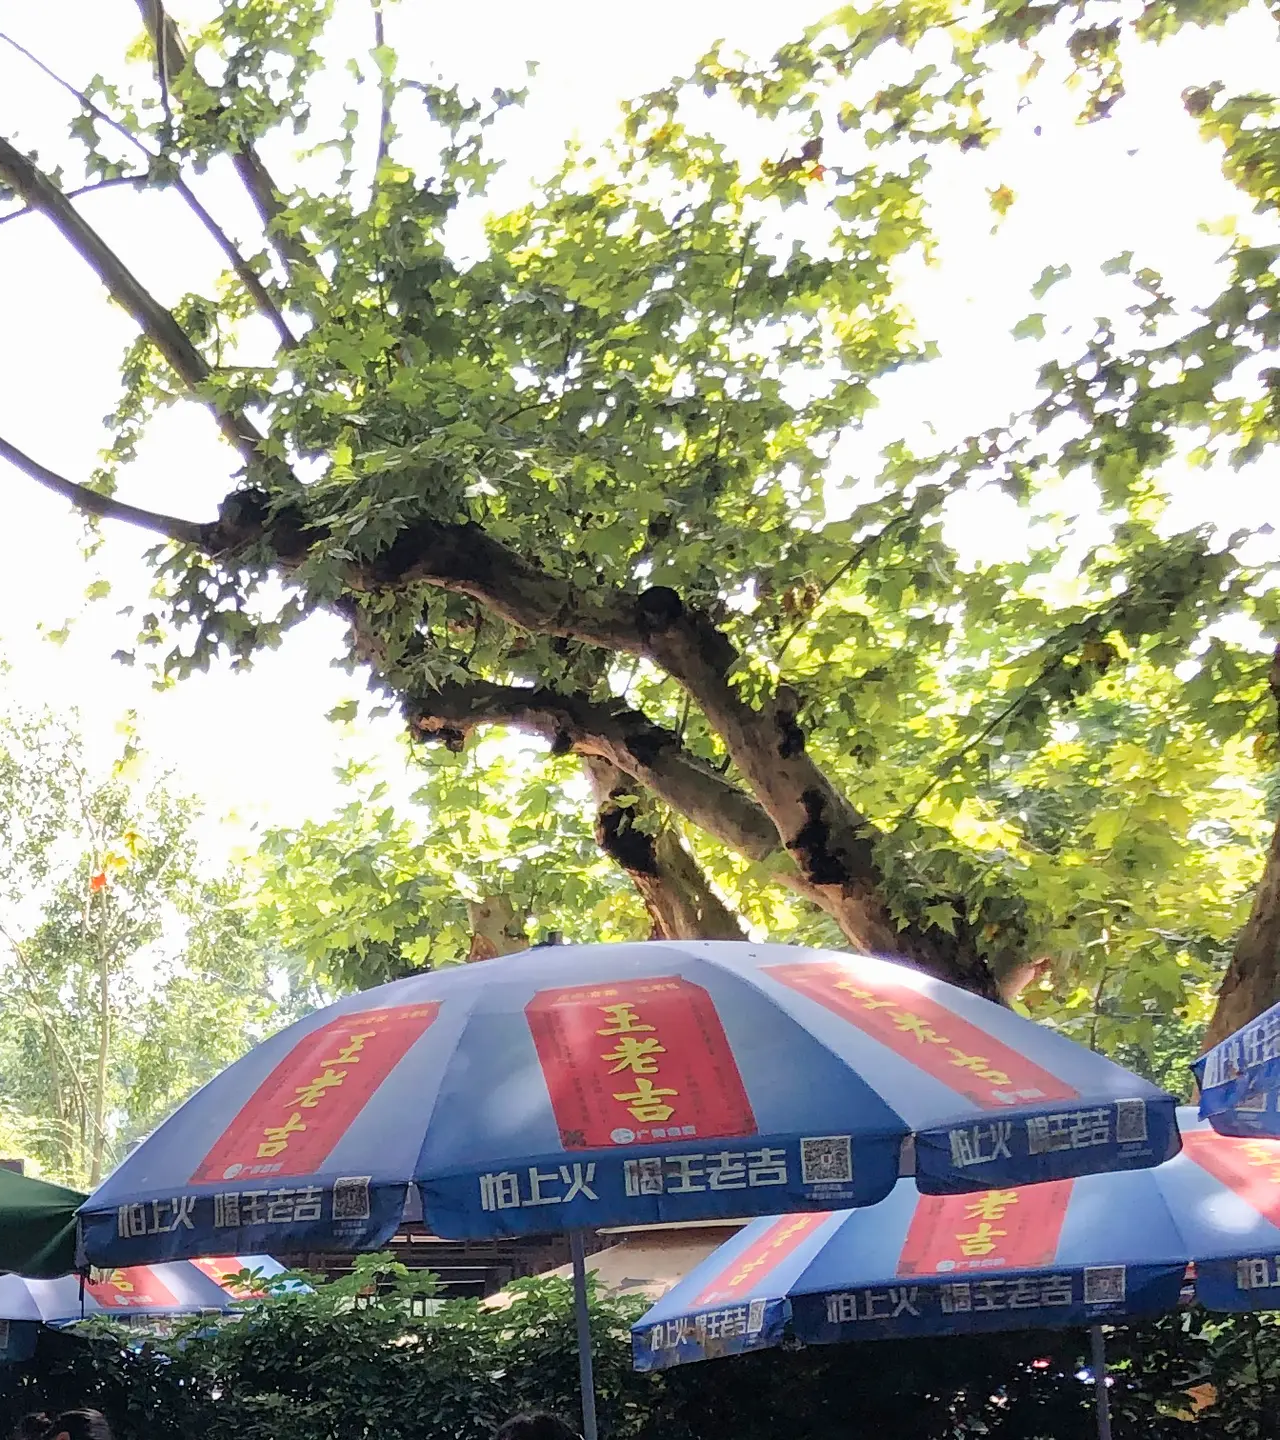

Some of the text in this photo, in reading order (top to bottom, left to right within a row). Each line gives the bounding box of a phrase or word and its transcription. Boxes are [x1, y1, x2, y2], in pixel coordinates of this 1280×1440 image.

[596, 1002, 678, 1122] 王老吉
[834, 981, 1011, 1086] 王老吉
[258, 1031, 376, 1158] 王老吉
[948, 1110, 1112, 1169] 怕上火 喝王老吉
[117, 1185, 324, 1238] 怕上火 喝王老吉
[478, 1148, 788, 1212] 怕上火 喝王老吉
[955, 1190, 1021, 1257] 老吉
[825, 1275, 1073, 1324] 怕上火 喝王老吉
